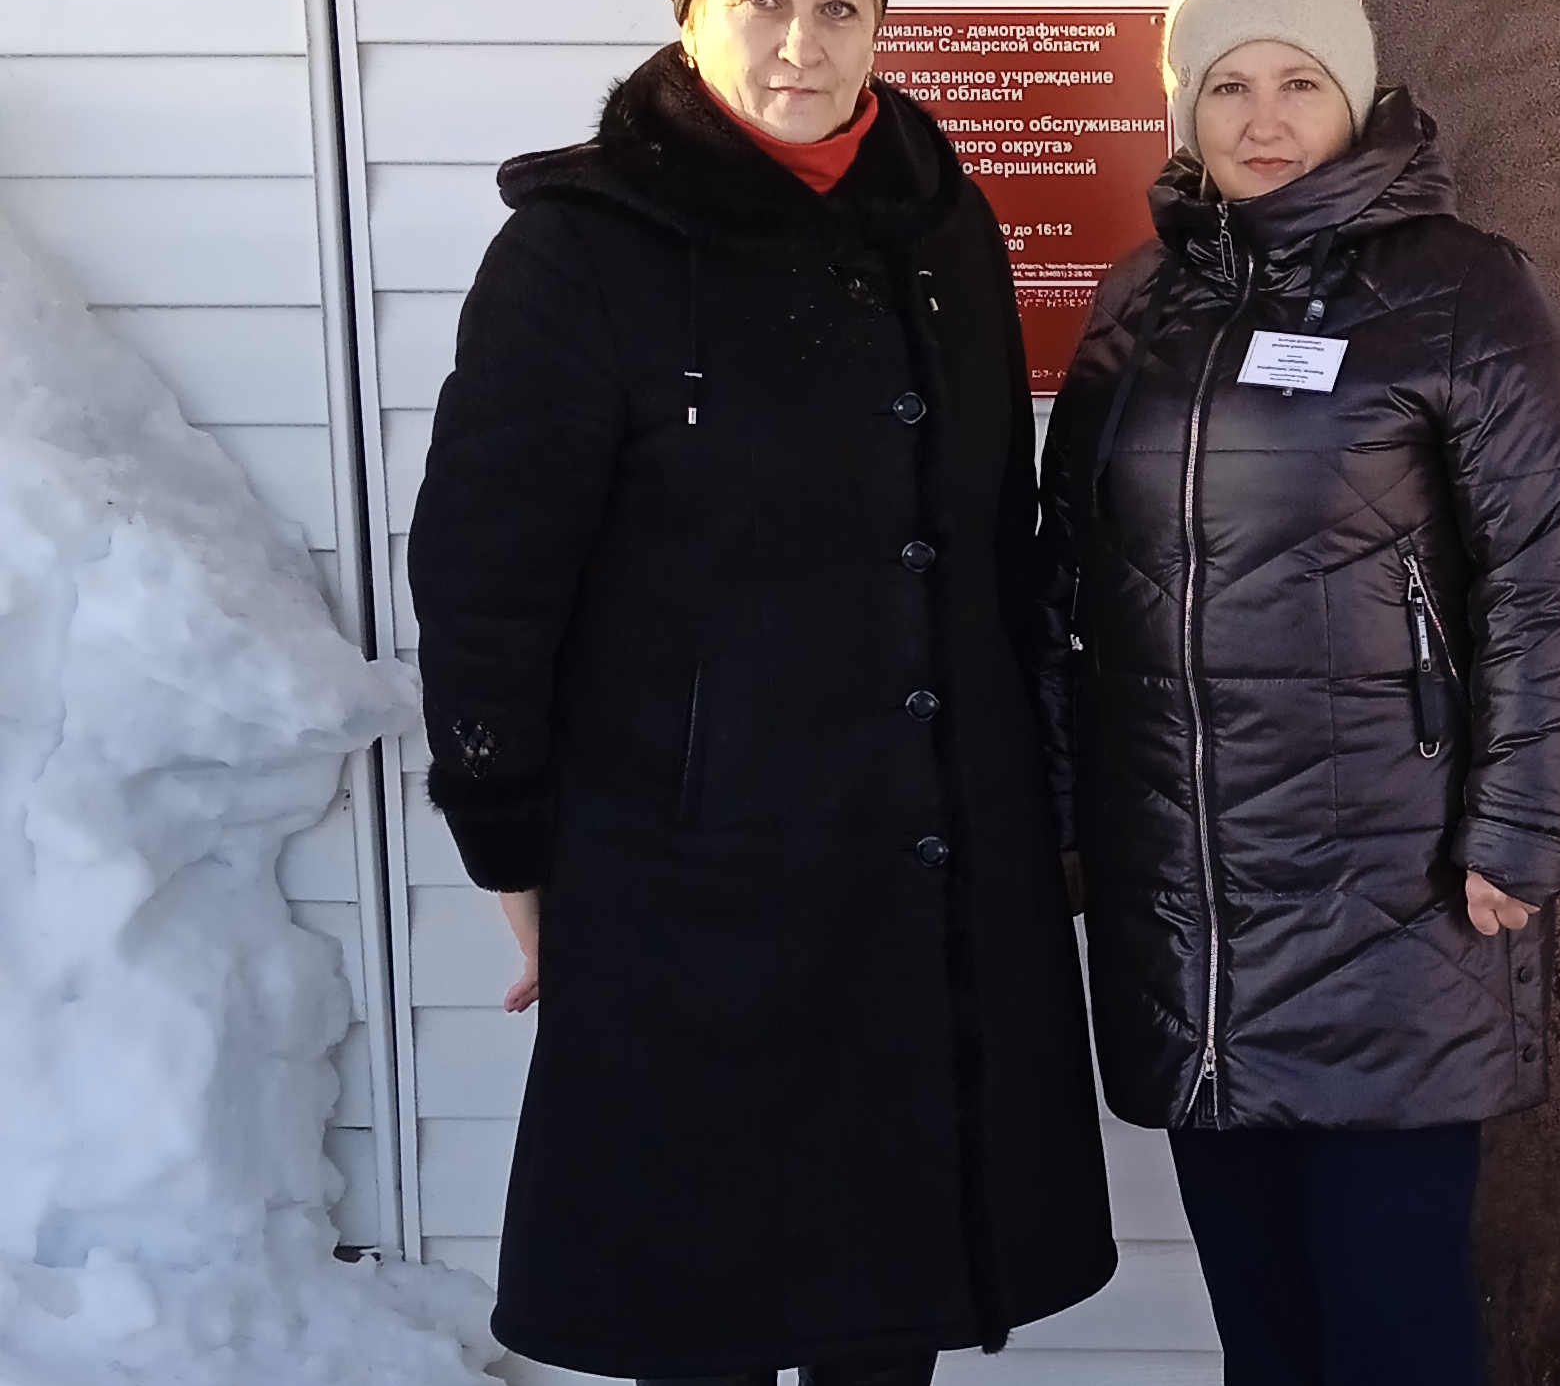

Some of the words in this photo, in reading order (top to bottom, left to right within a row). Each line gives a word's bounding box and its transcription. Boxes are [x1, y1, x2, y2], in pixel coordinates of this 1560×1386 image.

[966, 22, 1116, 40] демографической
[938, 38, 1029, 55] Самарской
[1032, 38, 1100, 52] области
[911, 71, 996, 84] казенное
[1000, 71, 1114, 87] учреждение
[946, 85, 1023, 101] области
[1029, 116, 1165, 136] обслуживания
[949, 140, 997, 153] ного
[1001, 140, 1073, 157] округа»
[961, 159, 1097, 178] о-Вершинский
[998, 224, 1011, 236] 0
[1013, 225, 1033, 238] до
[1035, 223, 1073, 236] 16:12
